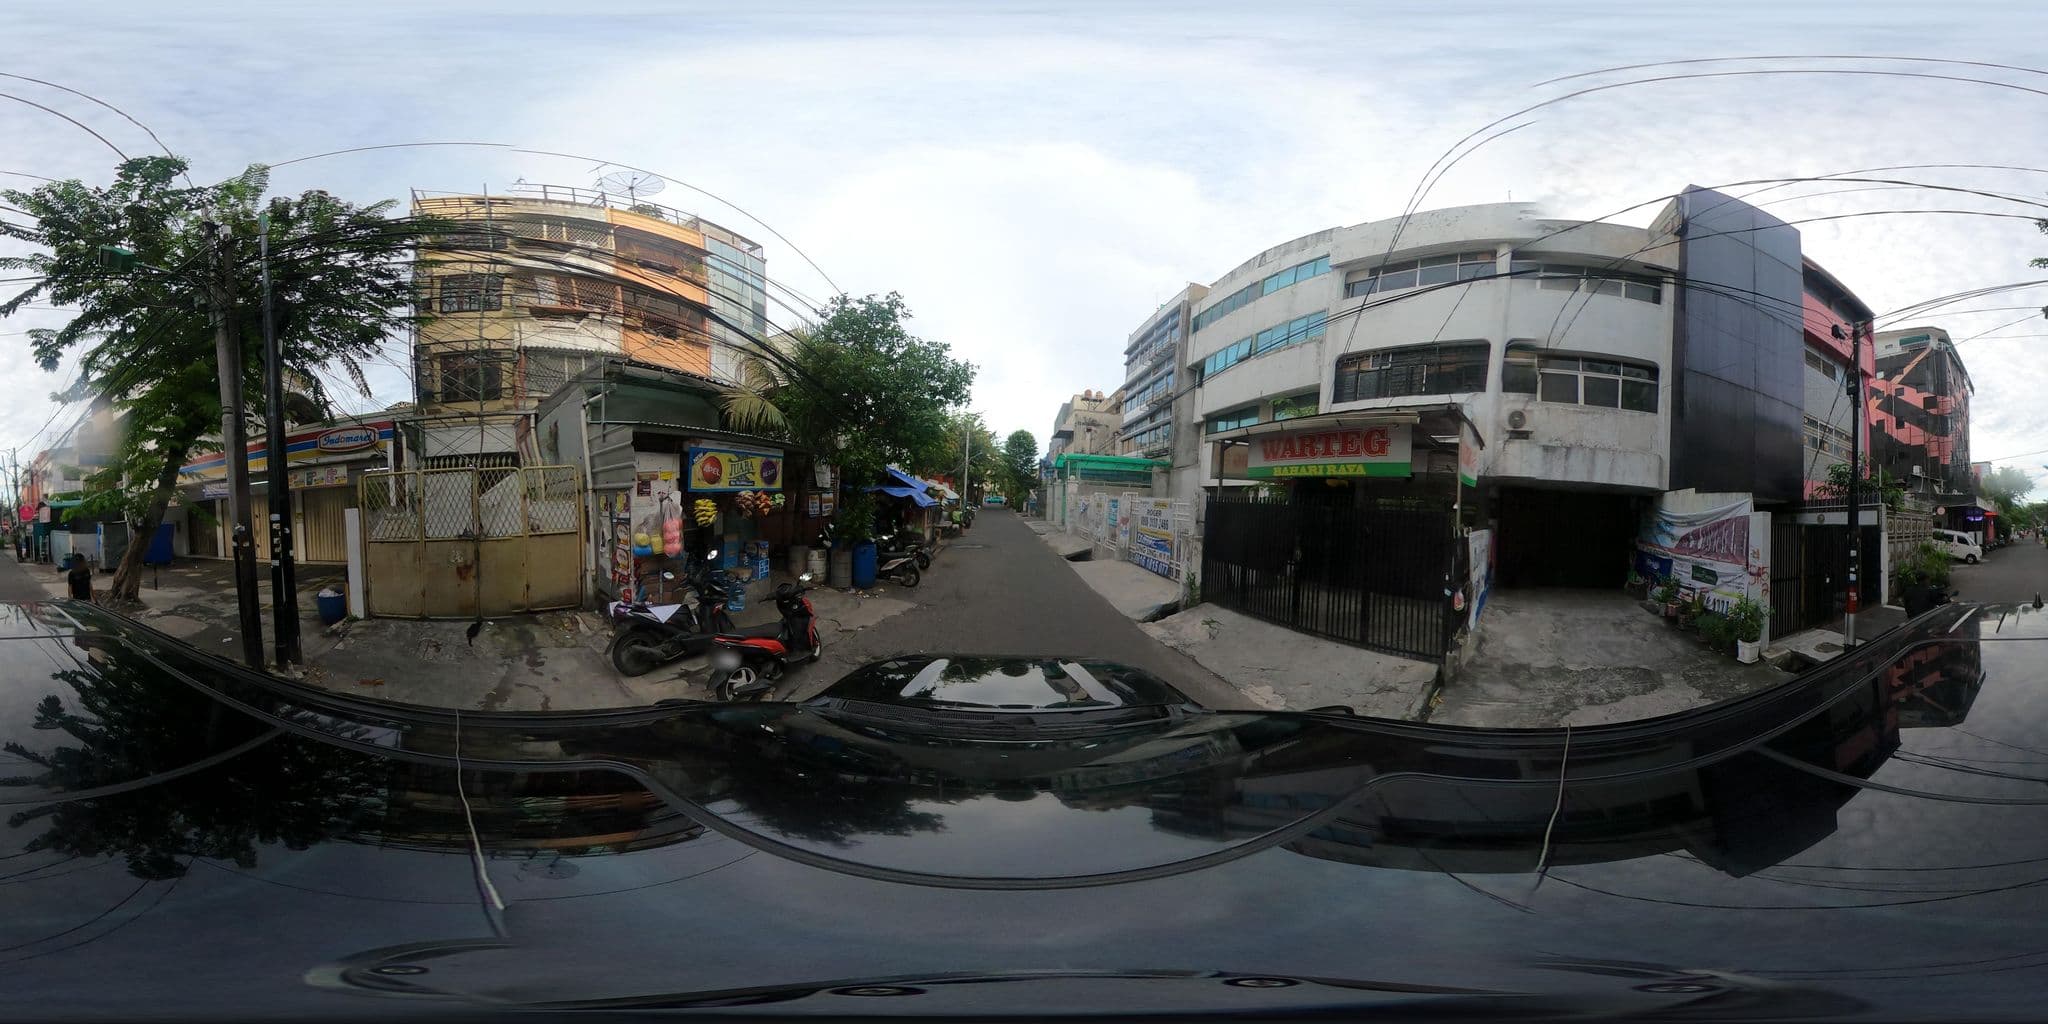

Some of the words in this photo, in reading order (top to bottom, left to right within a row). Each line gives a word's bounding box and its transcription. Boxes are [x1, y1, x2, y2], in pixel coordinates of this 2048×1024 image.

[1262, 428, 1391, 461] WARTEG
[1273, 465, 1324, 476] BAHARI
[1326, 464, 1366, 476] RAYA
